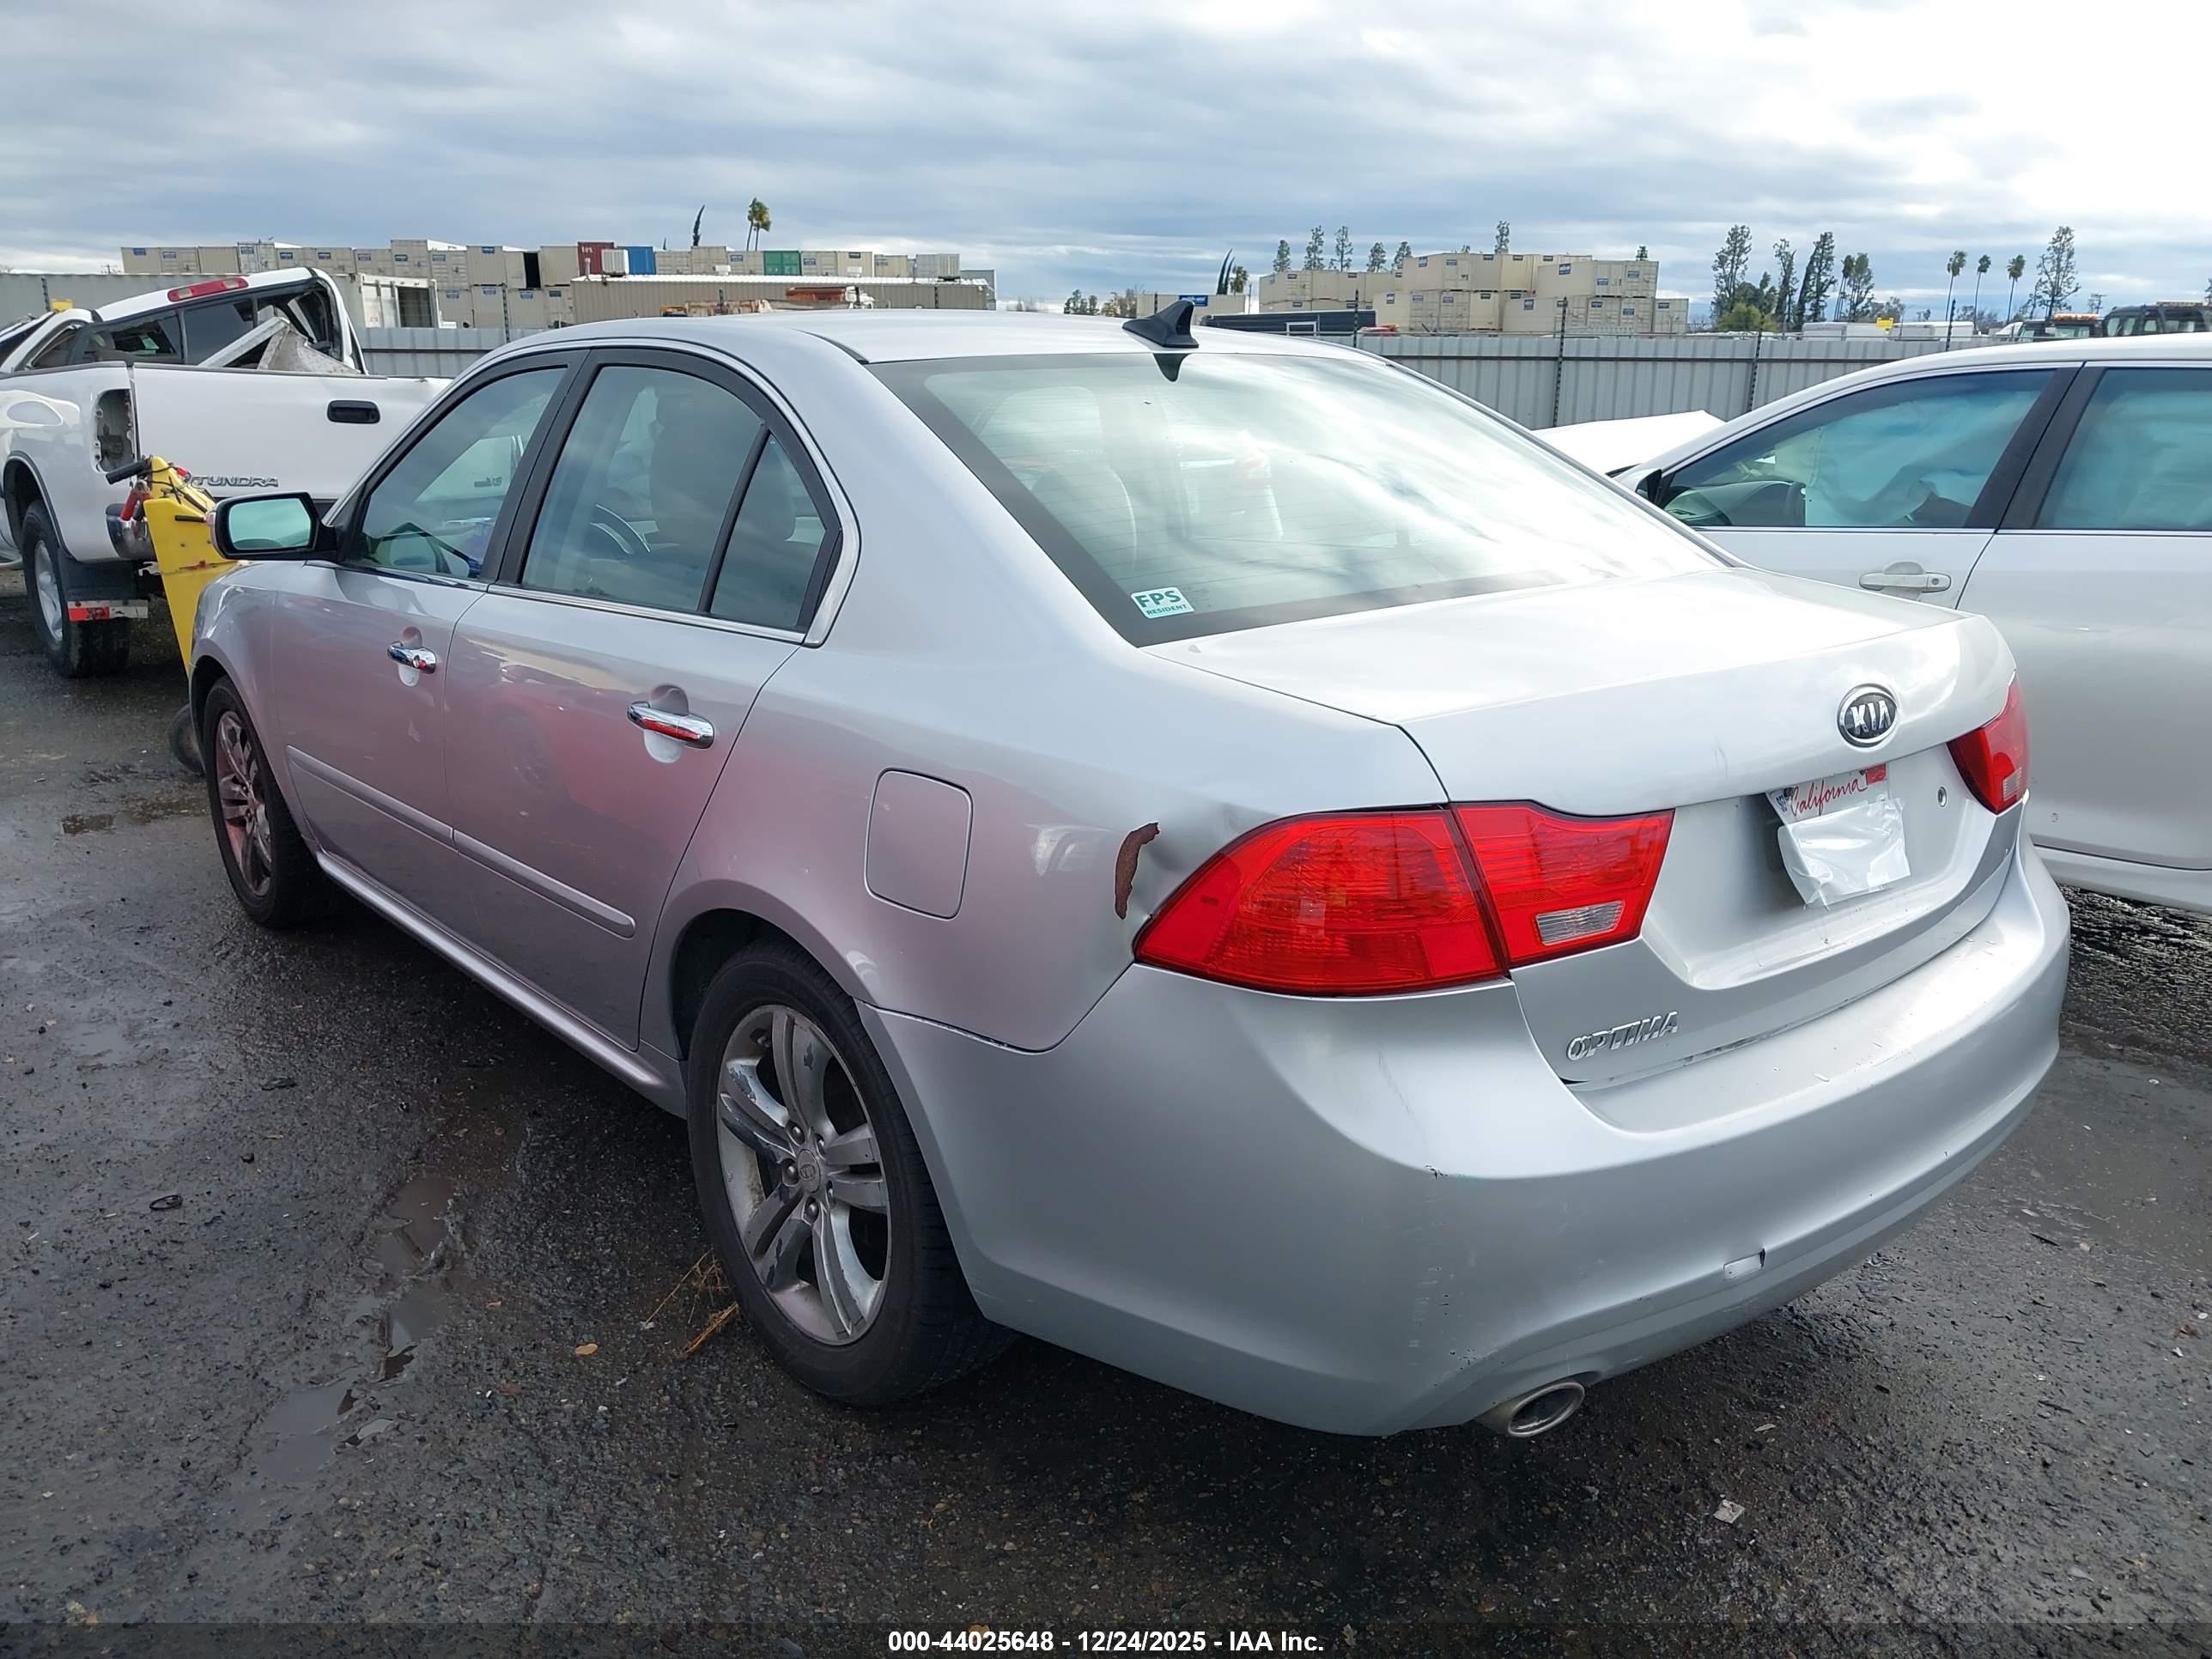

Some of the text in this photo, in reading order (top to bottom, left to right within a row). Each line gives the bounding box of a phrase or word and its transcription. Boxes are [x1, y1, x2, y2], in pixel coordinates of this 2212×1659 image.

[191, 476, 279, 488] TUNDRA
[1134, 591, 1182, 608] FPS
[1146, 604, 1188, 615] RESIDENT
[1850, 700, 1892, 735] KIA
[1788, 777, 1869, 817] California
[1566, 1011, 1678, 1061] OPTIMA
